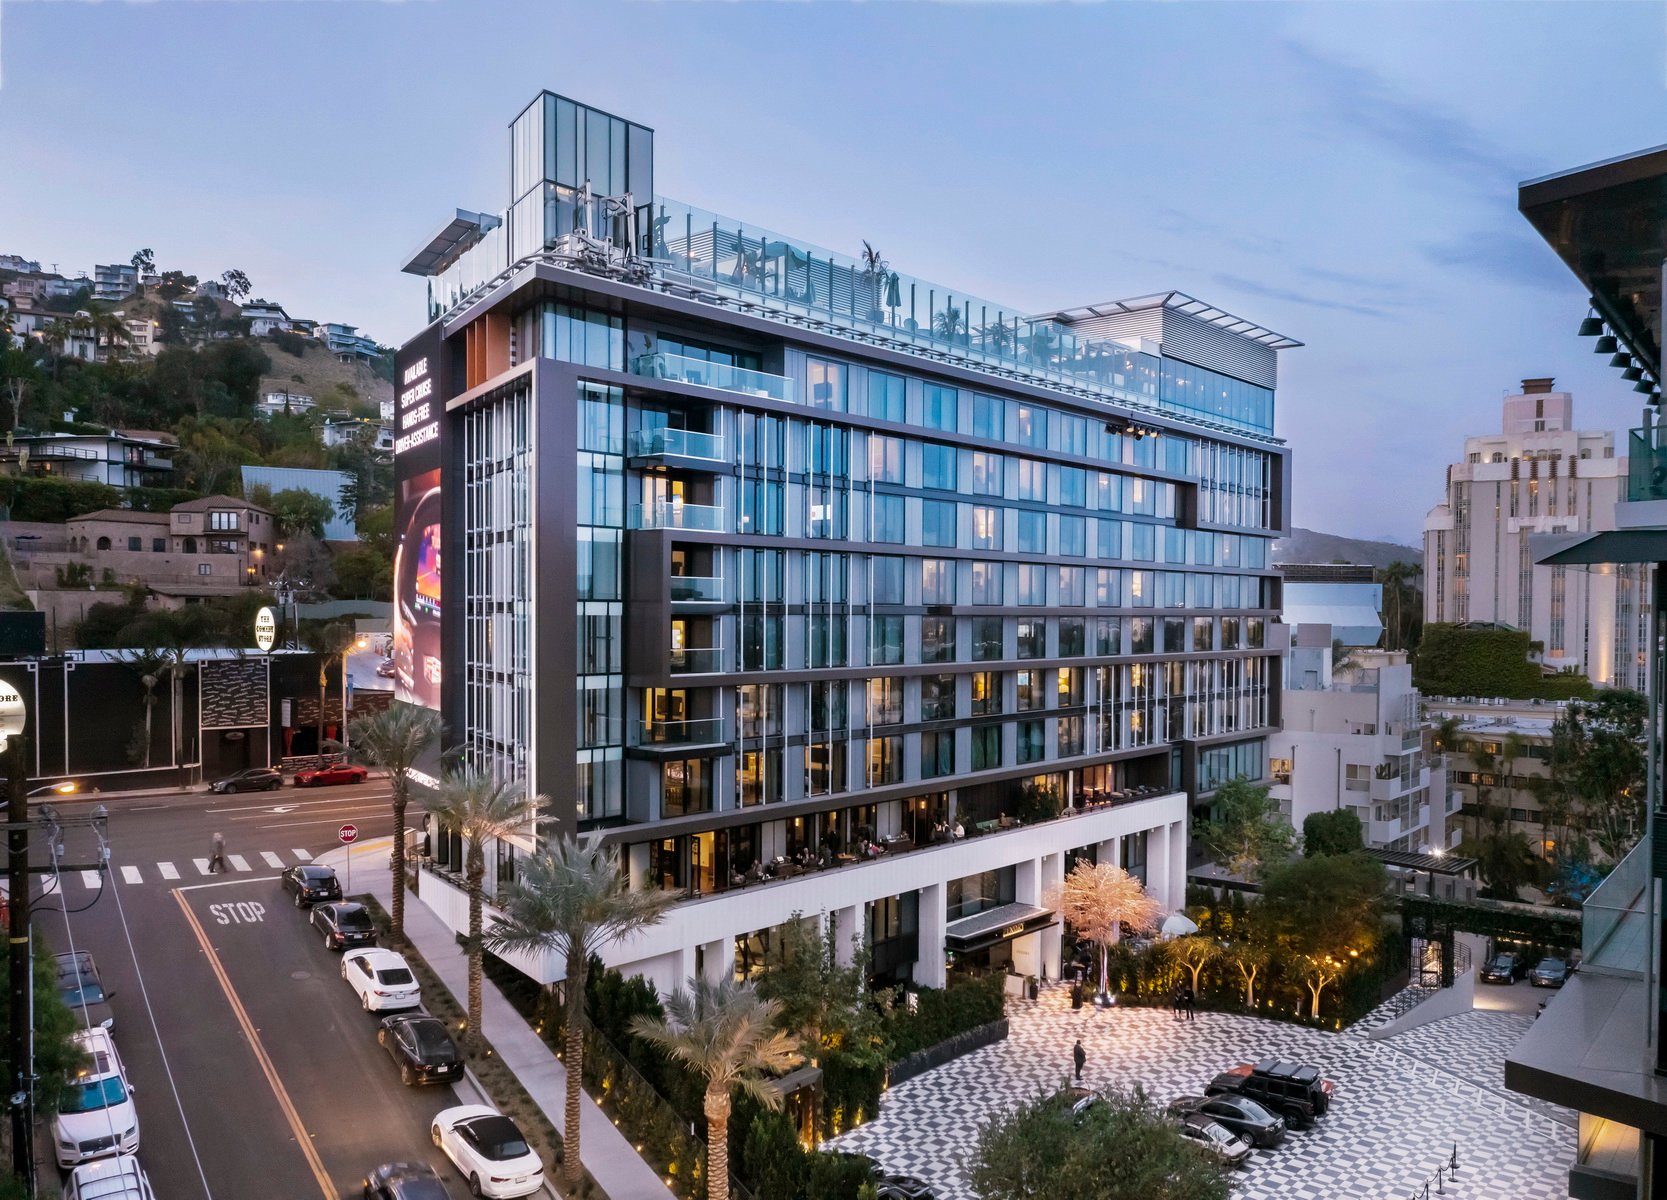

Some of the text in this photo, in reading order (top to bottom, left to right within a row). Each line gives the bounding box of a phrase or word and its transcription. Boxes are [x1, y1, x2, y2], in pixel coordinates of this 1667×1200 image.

[404, 358, 428, 385] AVAILABLE
[401, 378, 432, 408] SUPER CRUISE
[402, 402, 430, 430] HANDS-FREE
[395, 422, 438, 455] DRIVER-ASSISTANCE
[340, 829, 356, 838] STOP
[210, 902, 265, 925] STOP
